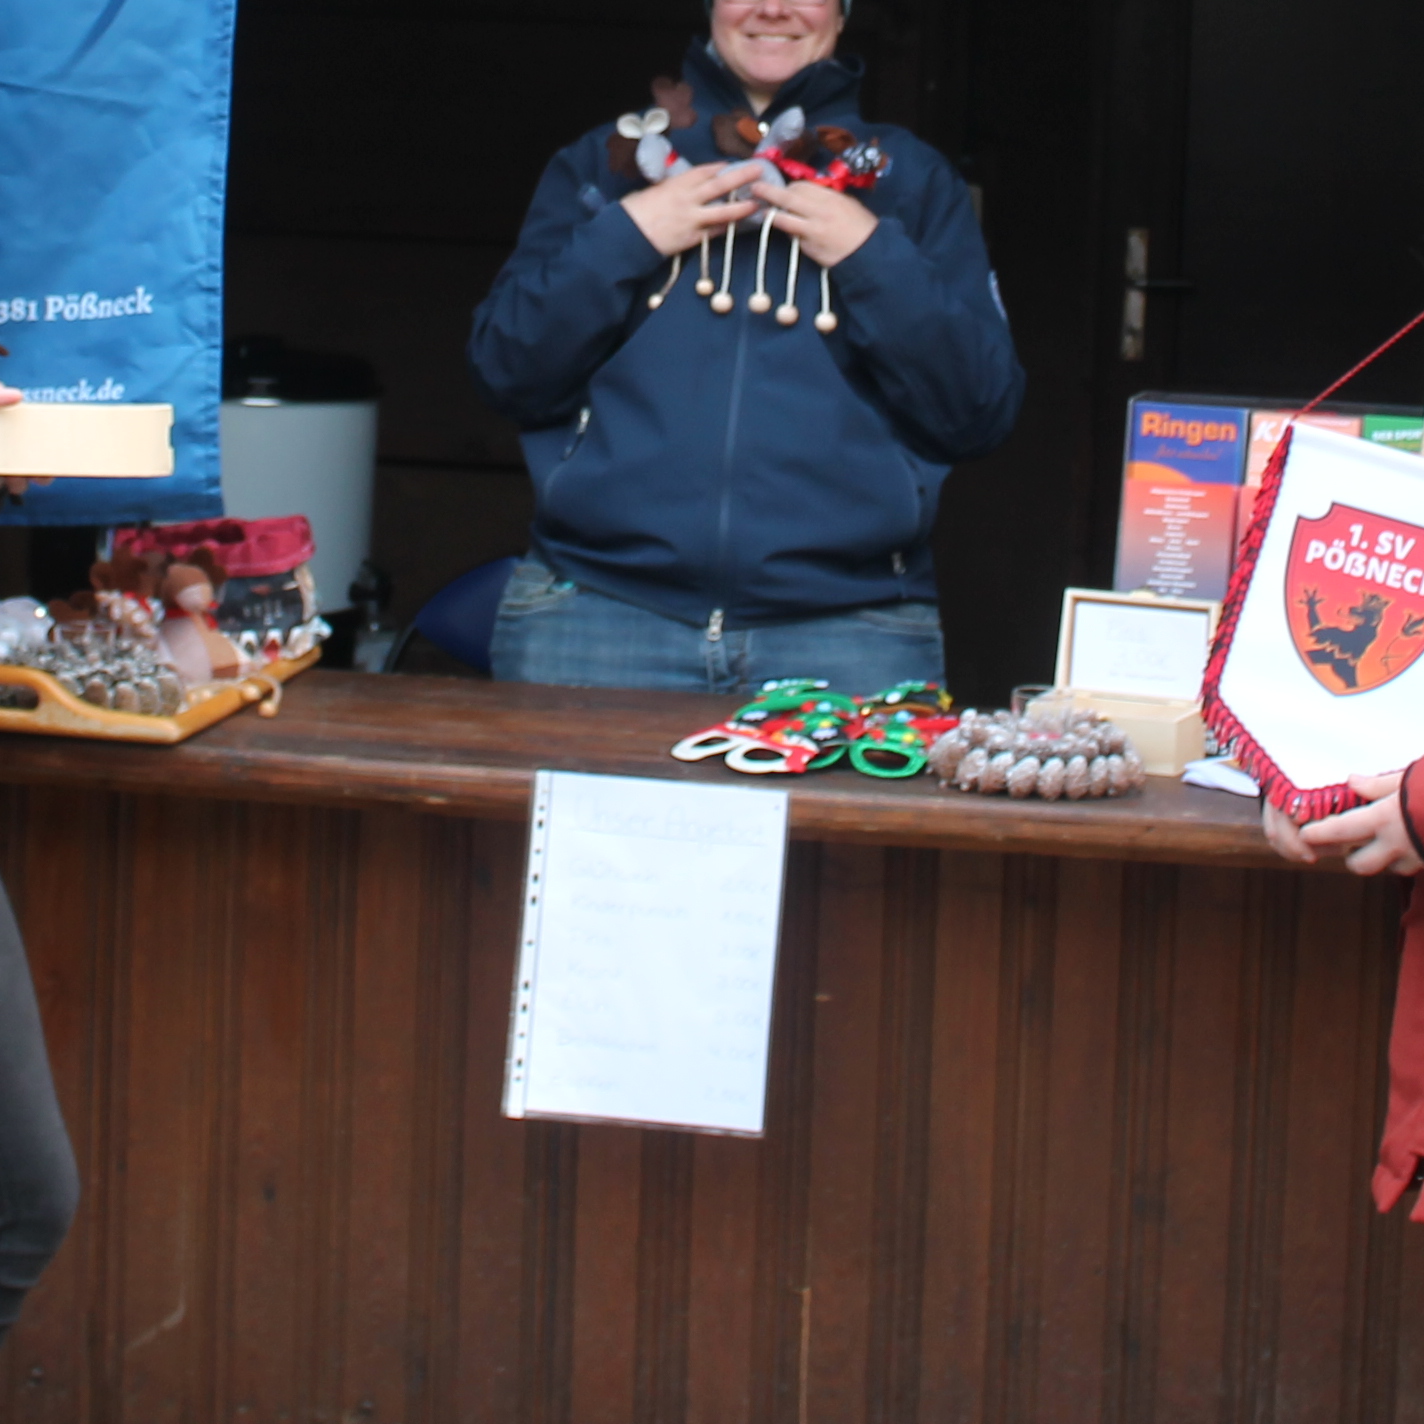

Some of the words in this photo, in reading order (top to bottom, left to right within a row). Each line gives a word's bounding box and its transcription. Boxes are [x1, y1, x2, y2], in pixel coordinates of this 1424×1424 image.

[44, 284, 155, 323] Pößneck
[1141, 412, 1237, 446] Ringen
[1349, 523, 1369, 550] 1.
[1374, 530, 1416, 560] SV
